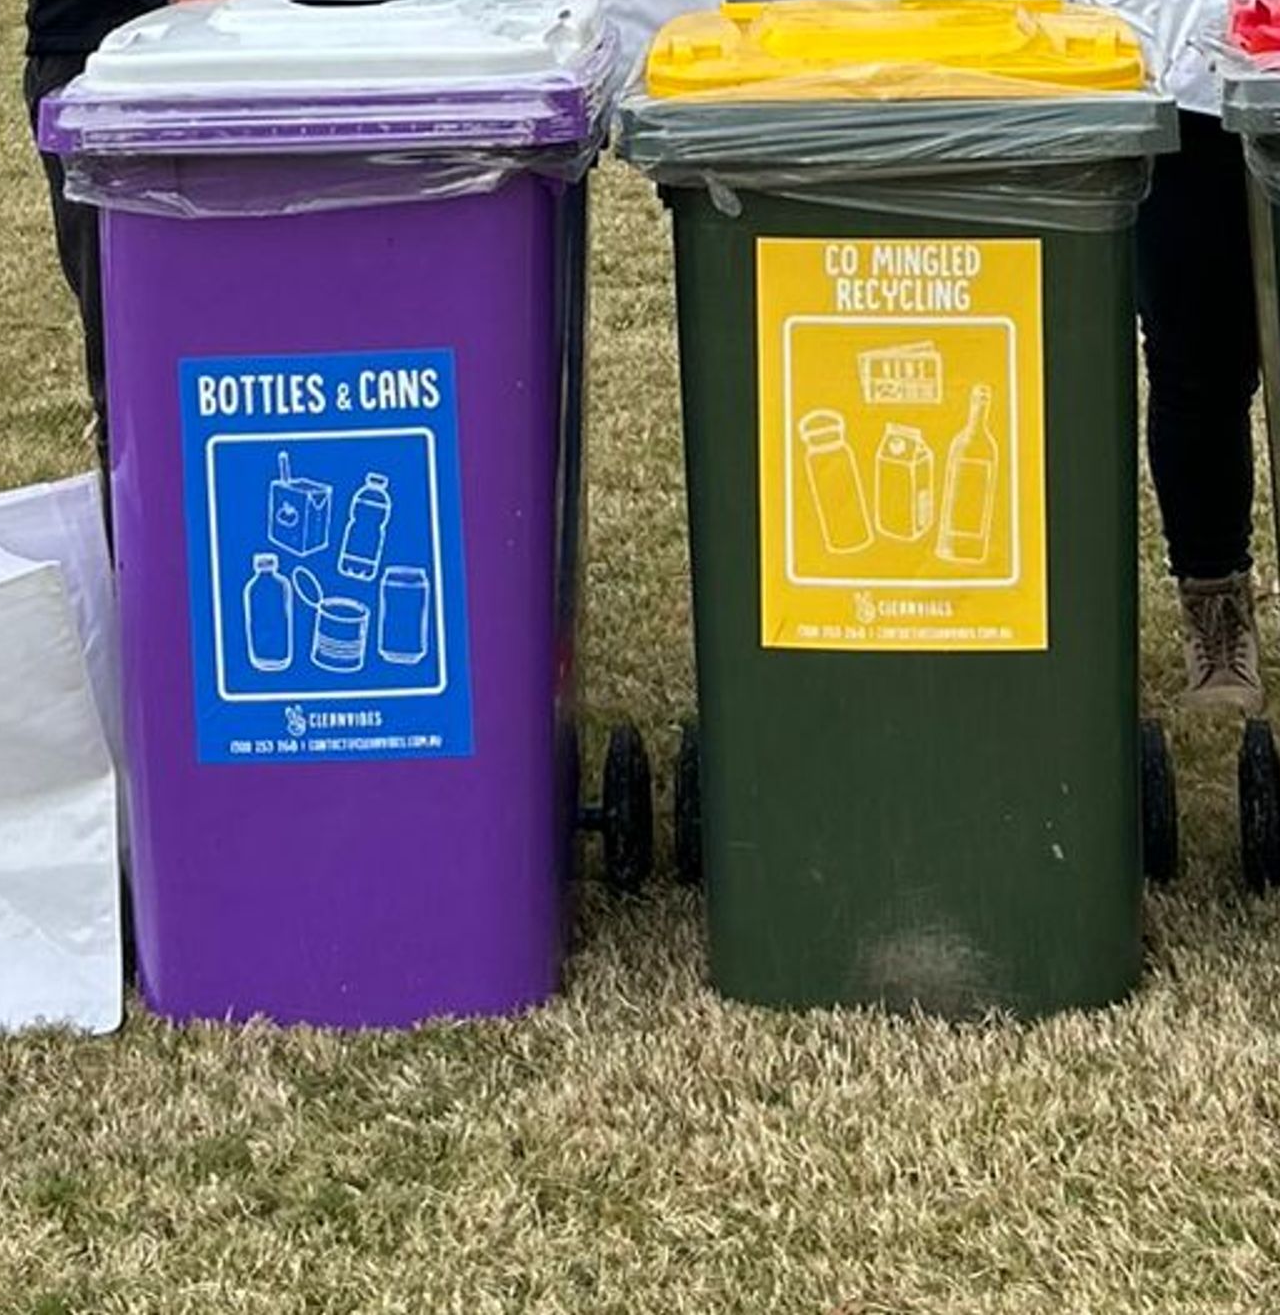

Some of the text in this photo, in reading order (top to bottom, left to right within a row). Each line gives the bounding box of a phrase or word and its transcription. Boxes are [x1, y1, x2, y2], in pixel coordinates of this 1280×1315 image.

[824, 244, 981, 277] CO MINGLED
[836, 279, 970, 312] RECYCLING
[197, 368, 441, 416] BOTTLES & CANS
